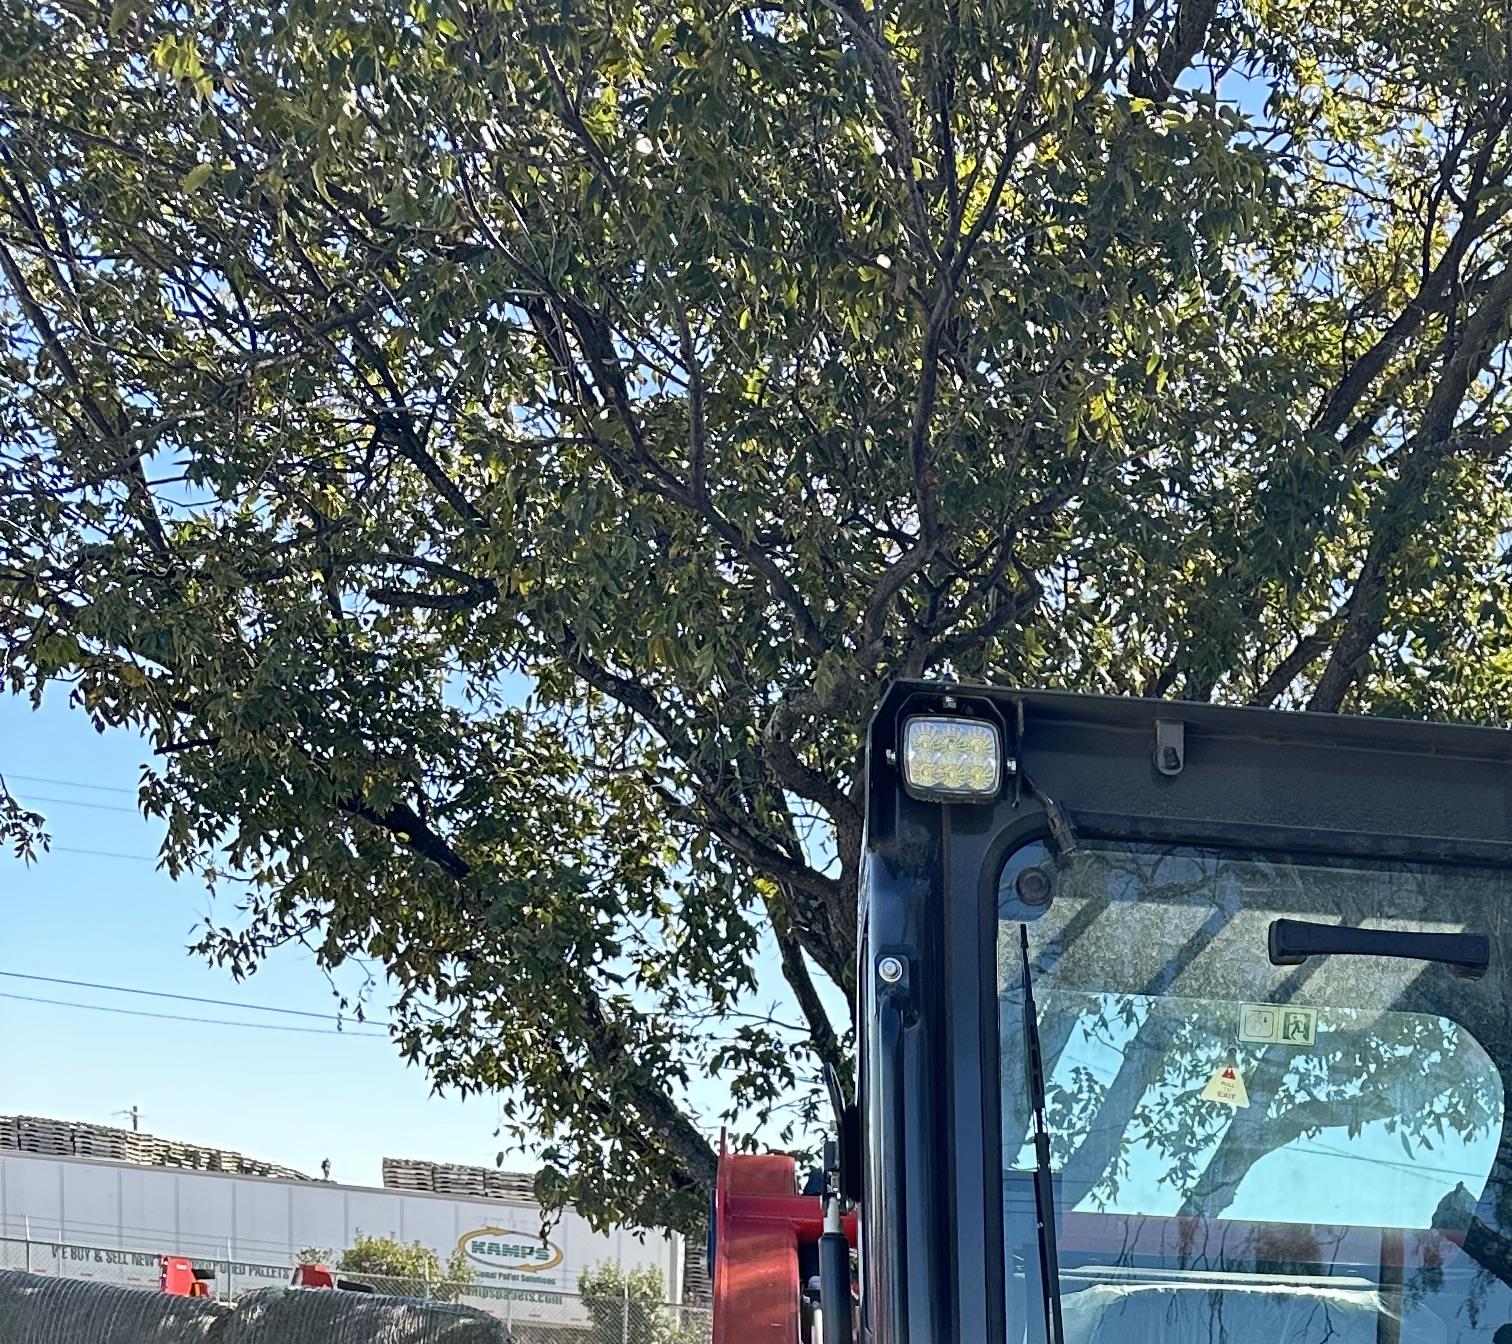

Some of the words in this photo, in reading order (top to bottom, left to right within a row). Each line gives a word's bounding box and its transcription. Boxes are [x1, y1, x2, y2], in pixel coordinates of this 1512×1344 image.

[1217, 1091, 1236, 1100] EXIT
[70, 1246, 90, 1261] BUY
[106, 1250, 128, 1266] SELL
[471, 1240, 550, 1261] KAMPS
[249, 1265, 290, 1280] PALLETS
